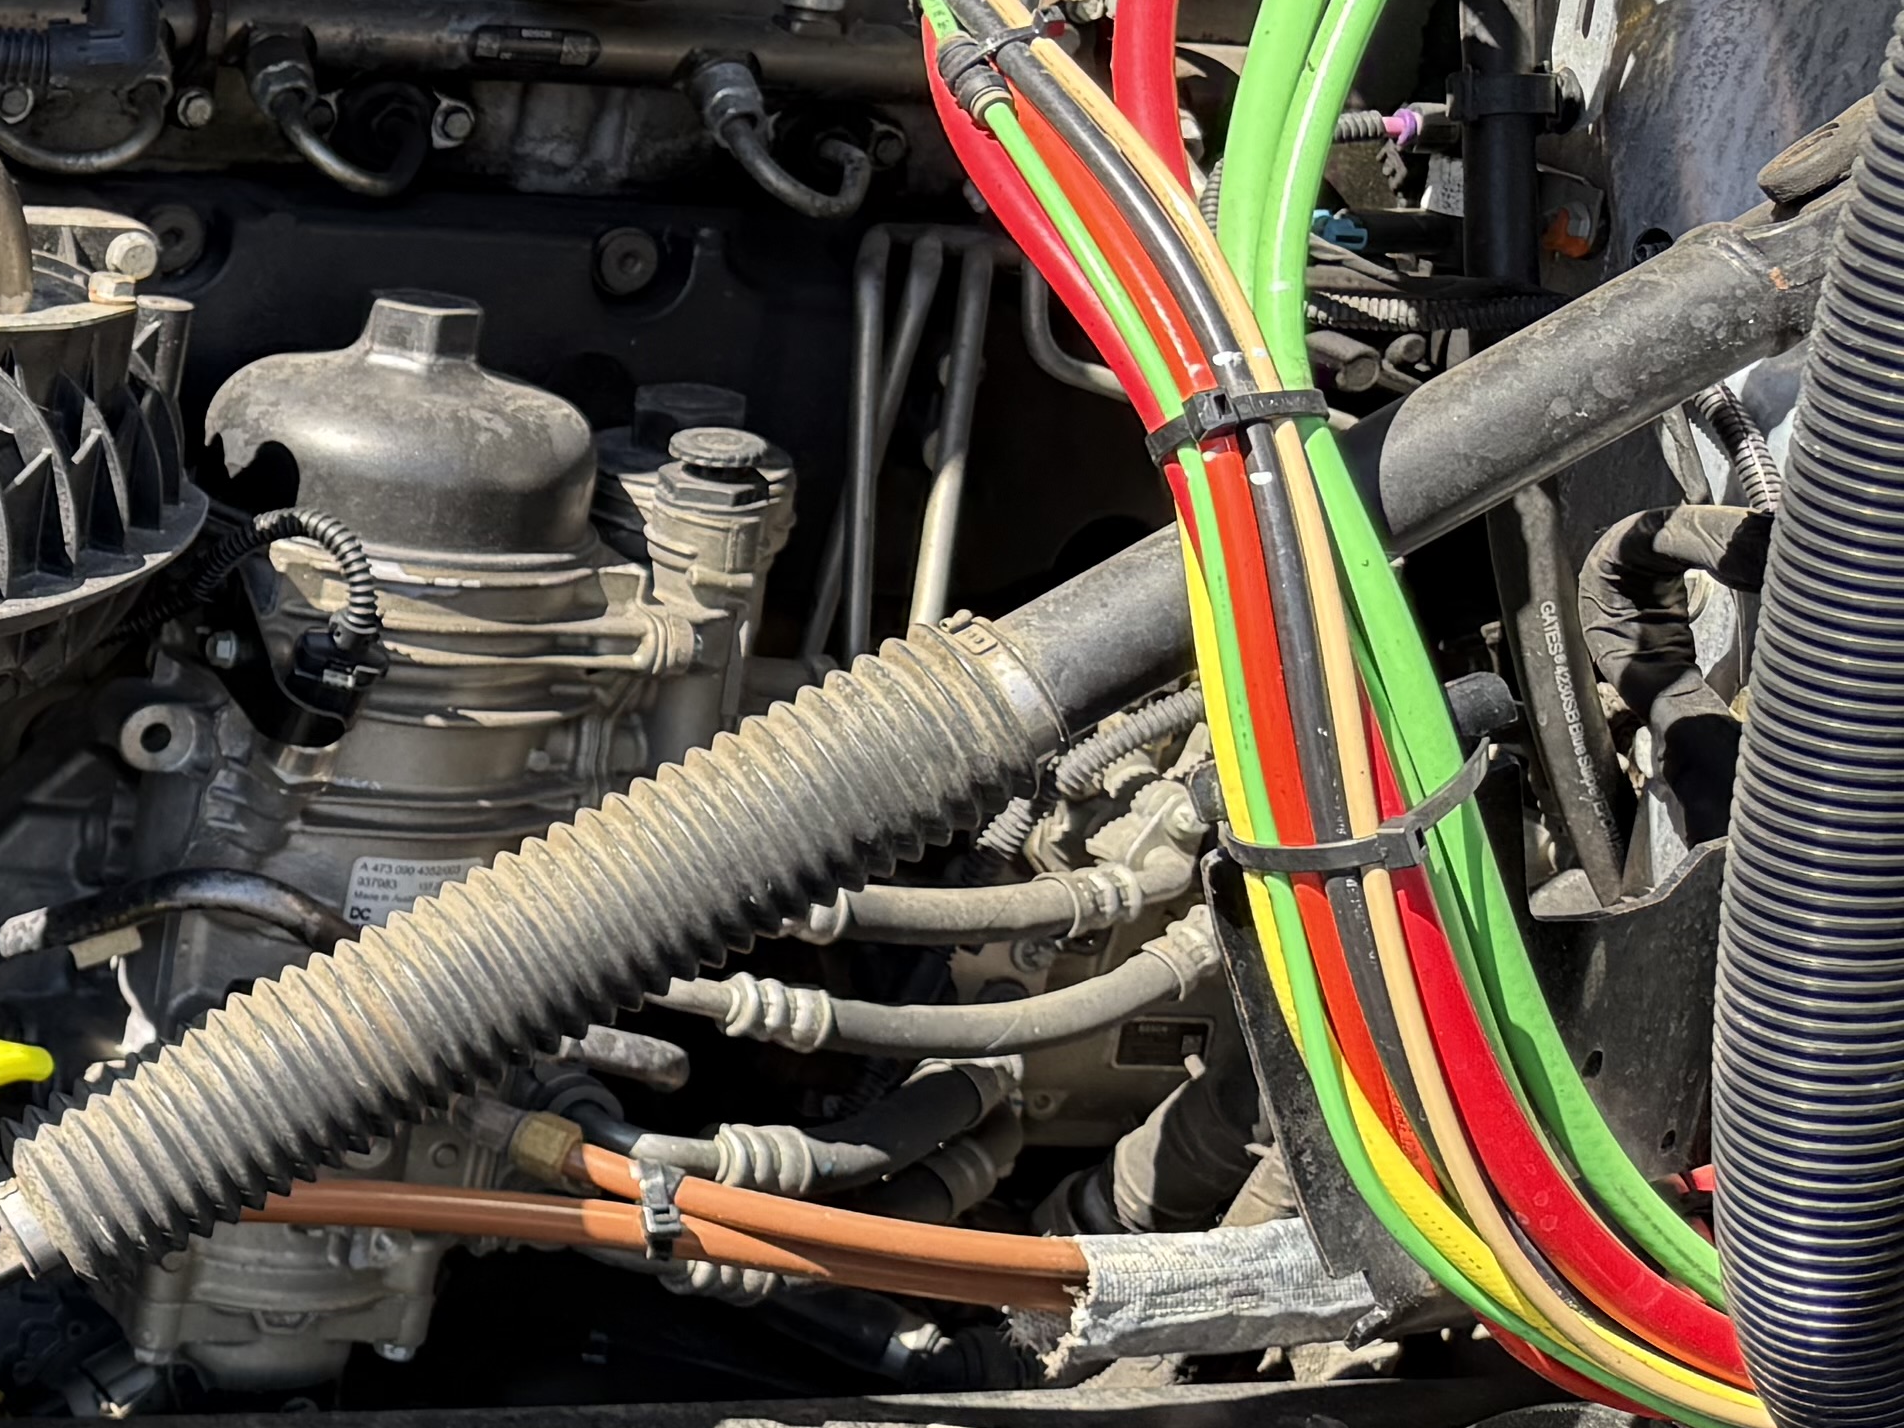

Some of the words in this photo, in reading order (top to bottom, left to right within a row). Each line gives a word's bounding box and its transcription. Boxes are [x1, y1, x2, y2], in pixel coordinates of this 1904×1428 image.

[360, 862, 368, 871] A
[372, 863, 393, 875] 473
[349, 906, 372, 920] DC
